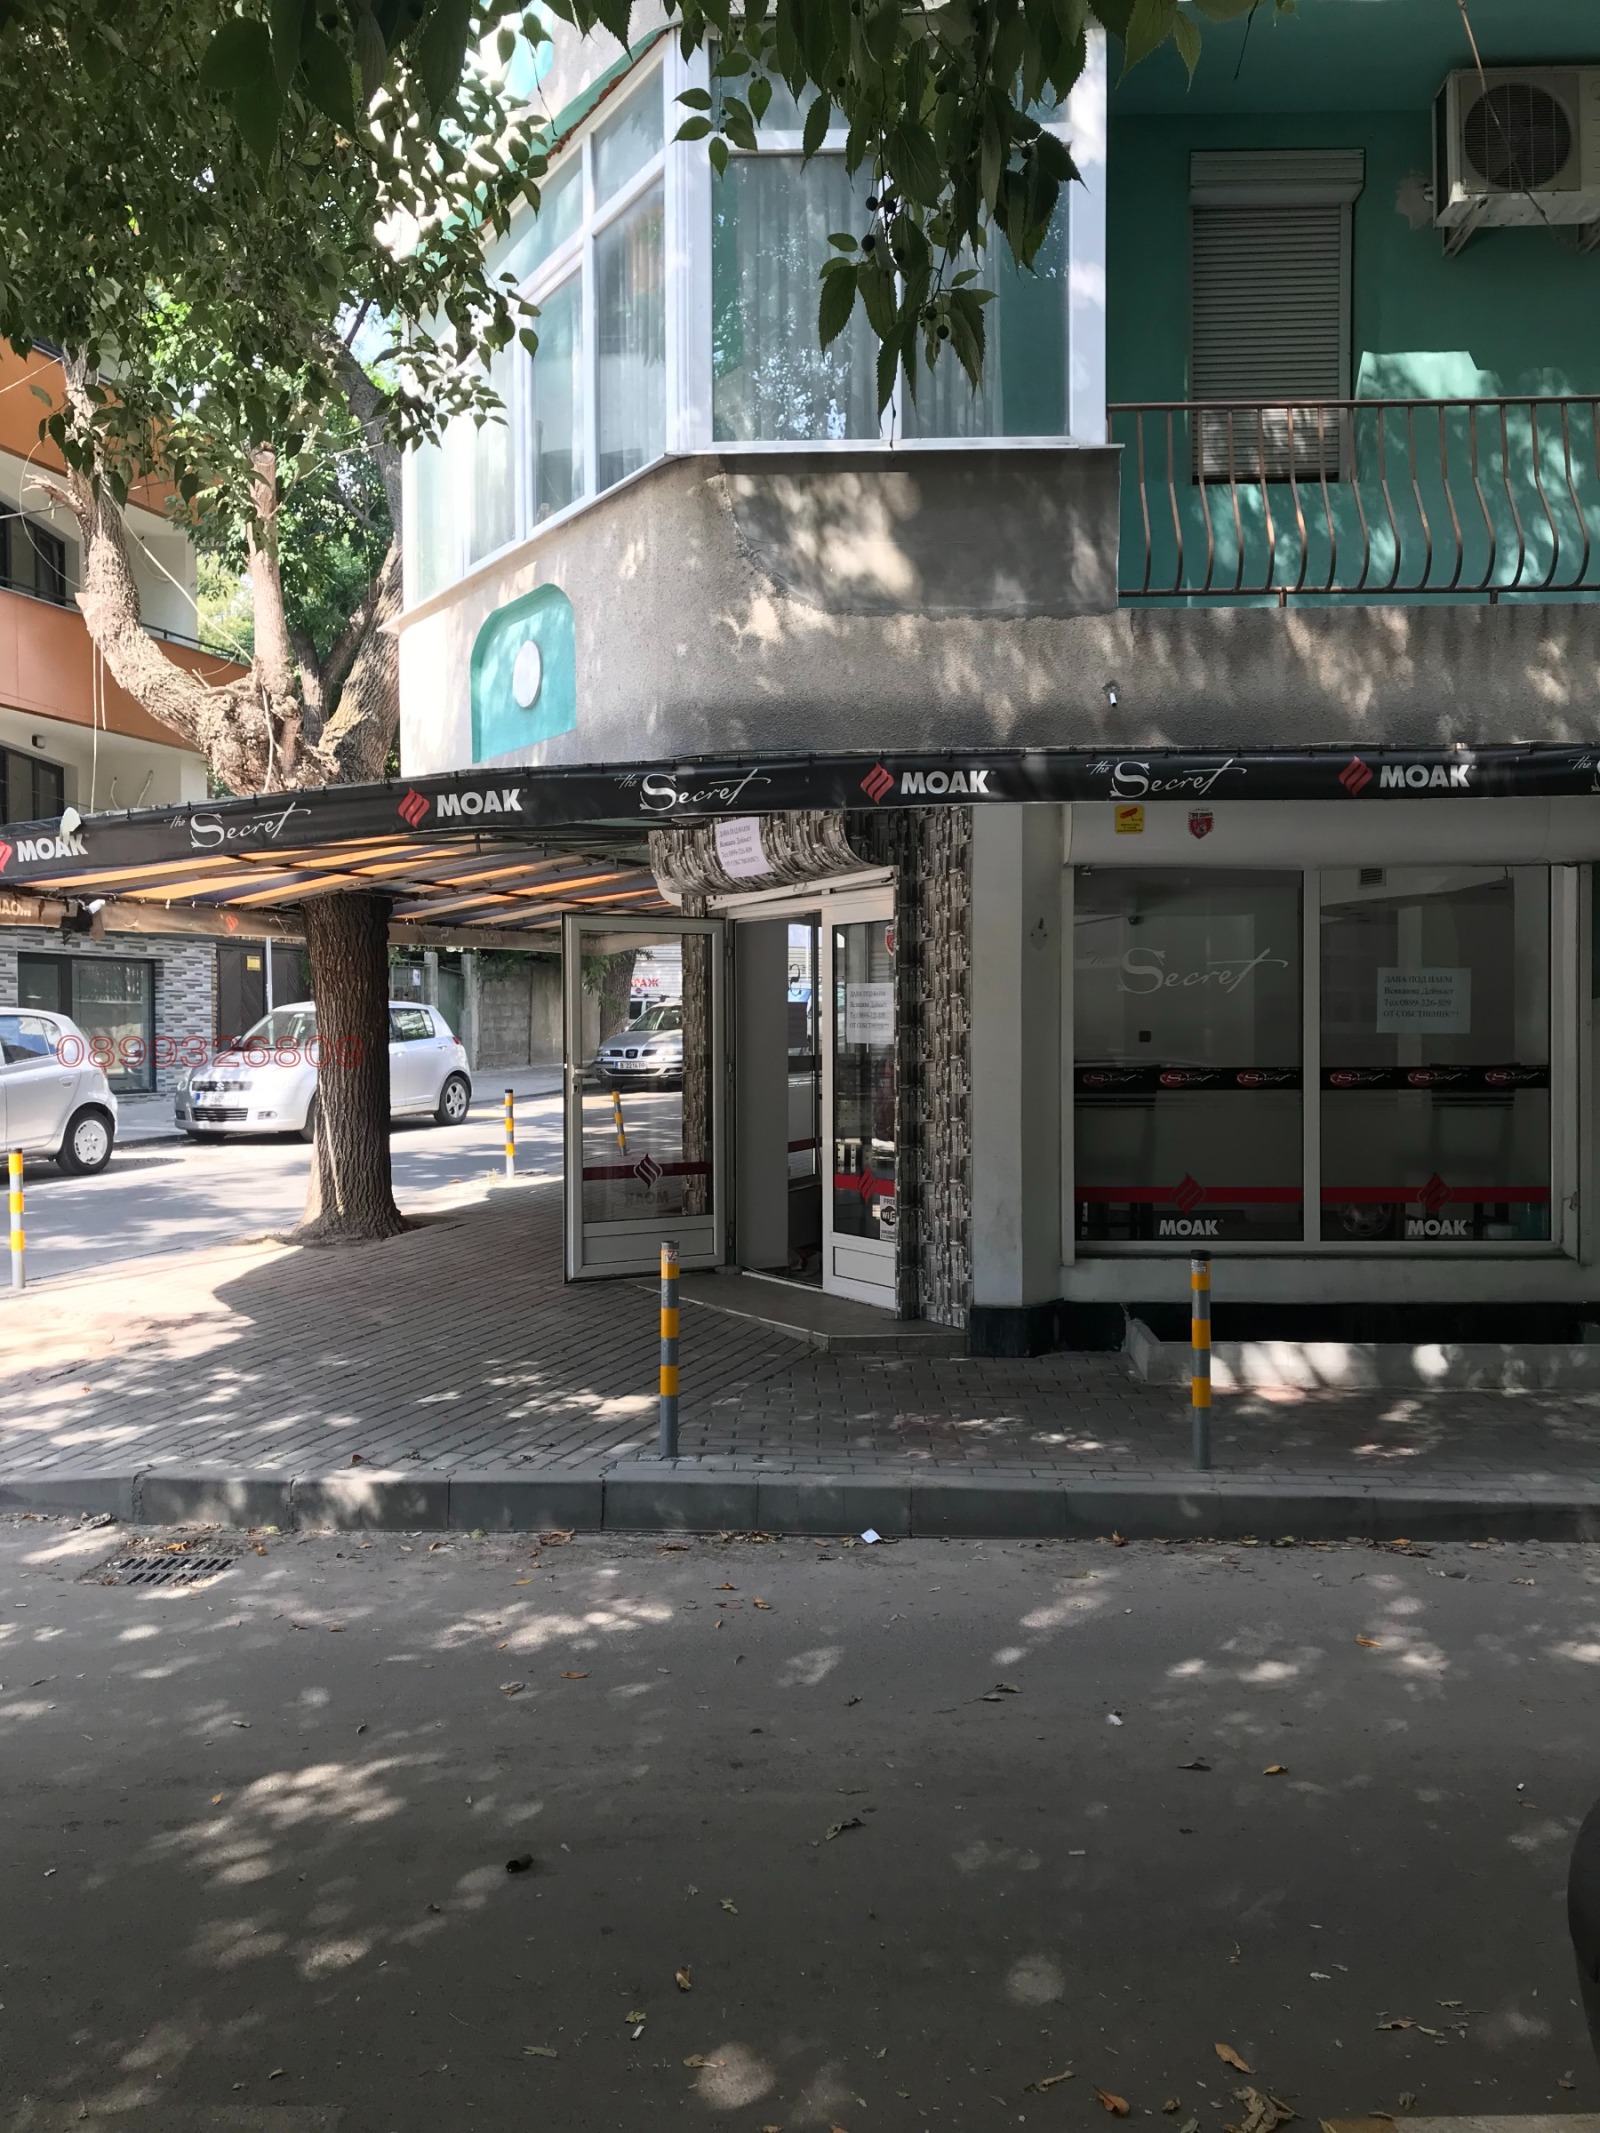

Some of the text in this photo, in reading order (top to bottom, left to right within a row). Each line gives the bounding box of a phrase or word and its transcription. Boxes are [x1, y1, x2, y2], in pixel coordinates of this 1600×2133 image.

[614, 769, 771, 811] the Secret
[901, 770, 989, 795] MOAK
[1086, 758, 1247, 798] the Secret
[1380, 764, 1470, 788] MOAK
[437, 788, 523, 818] MOAK
[163, 801, 311, 848] the Secret
[17, 833, 88, 862] MOAK
[1117, 947, 1288, 994] Secret
[1159, 1219, 1219, 1236] MOAK
[1407, 1219, 1467, 1236] MOAK
